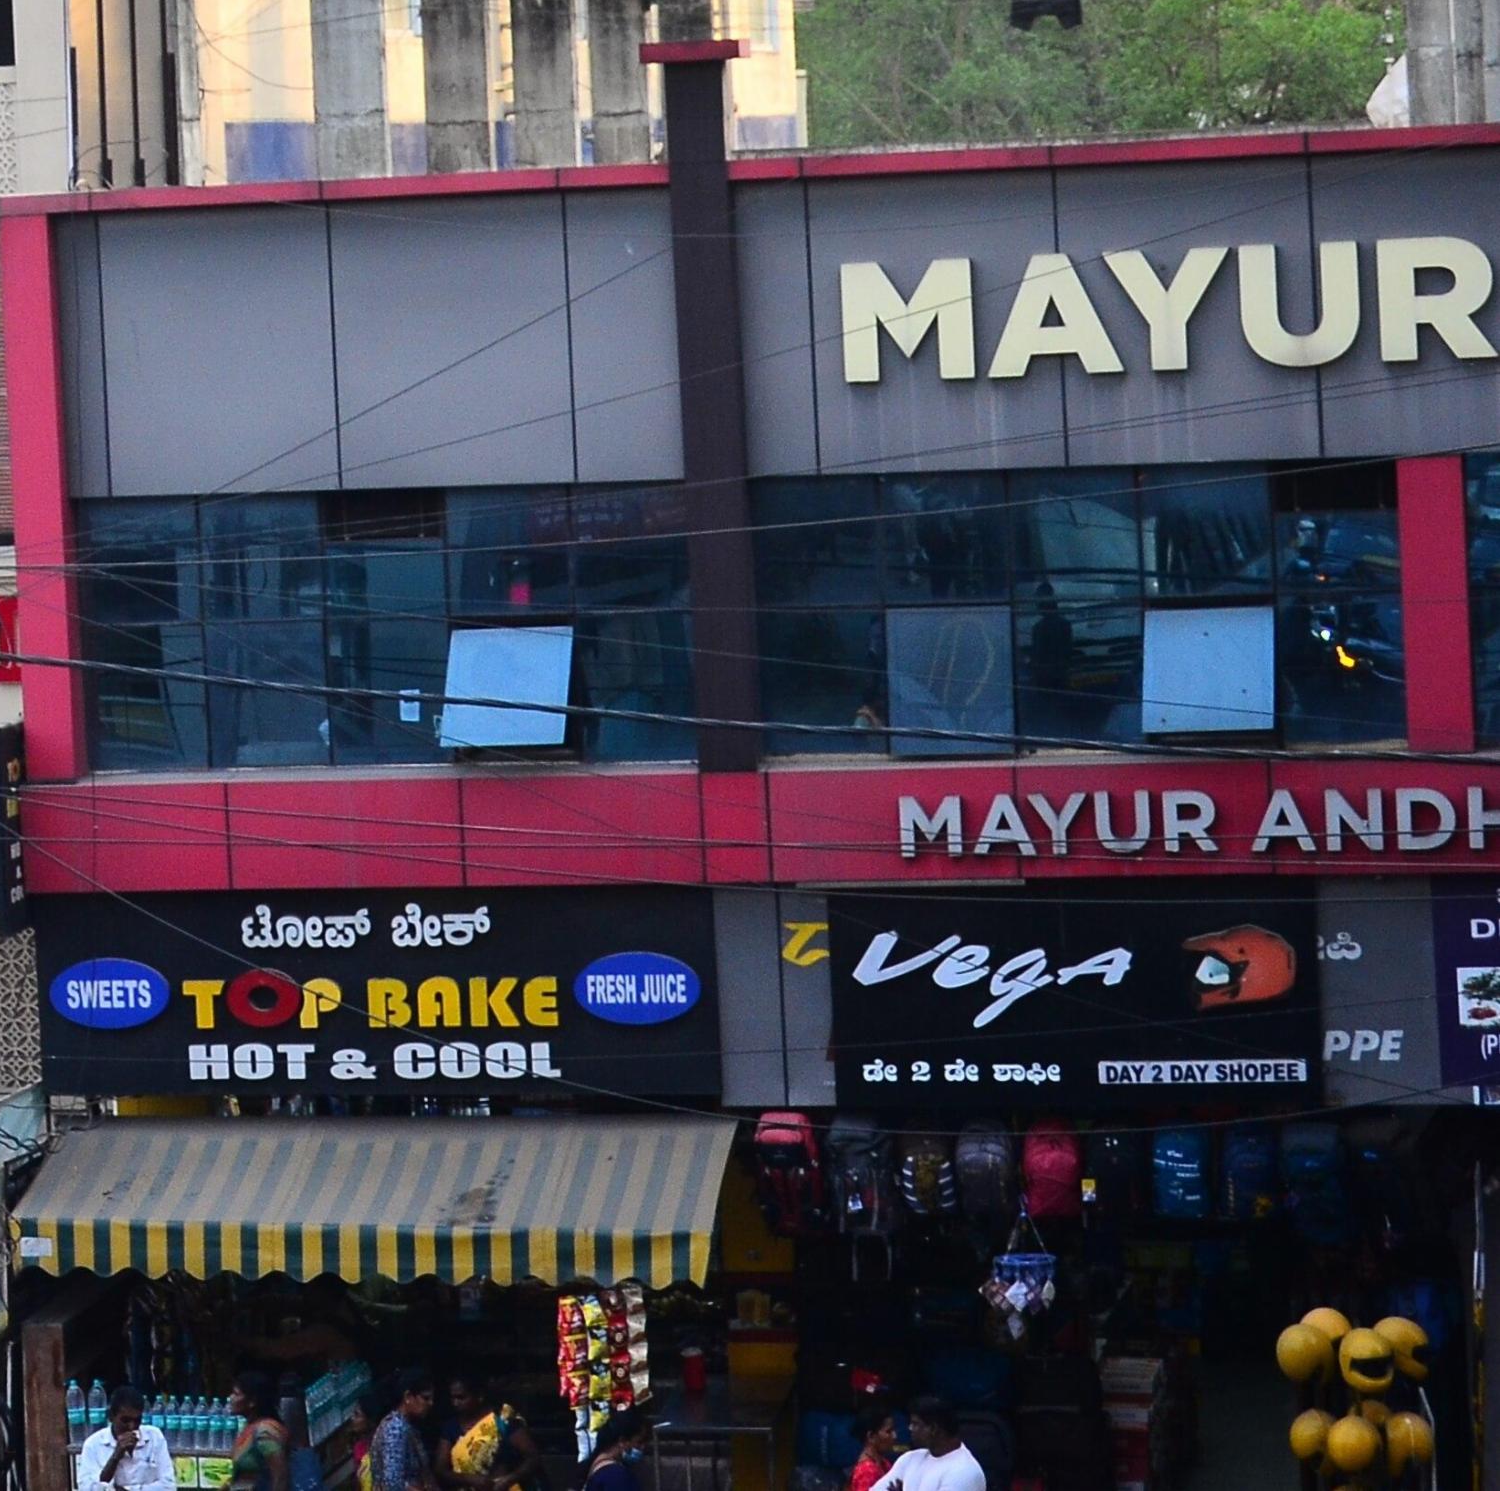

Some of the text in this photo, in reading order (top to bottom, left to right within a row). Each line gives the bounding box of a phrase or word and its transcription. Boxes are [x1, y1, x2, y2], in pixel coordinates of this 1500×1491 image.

[839, 236, 1500, 384] MAYUR
[899, 790, 1218, 858] MAYUR
[66, 978, 152, 1011] SWEETS
[182, 967, 559, 1030] TOP BAKE
[586, 971, 688, 1006] FRESH JUICE
[188, 1041, 562, 1082] HOT & COOL
[1323, 1029, 1405, 1061] PPE
[911, 1060, 931, 1083] 2
[1105, 1061, 1301, 1083] DAY 2 DAY SHOPEE
